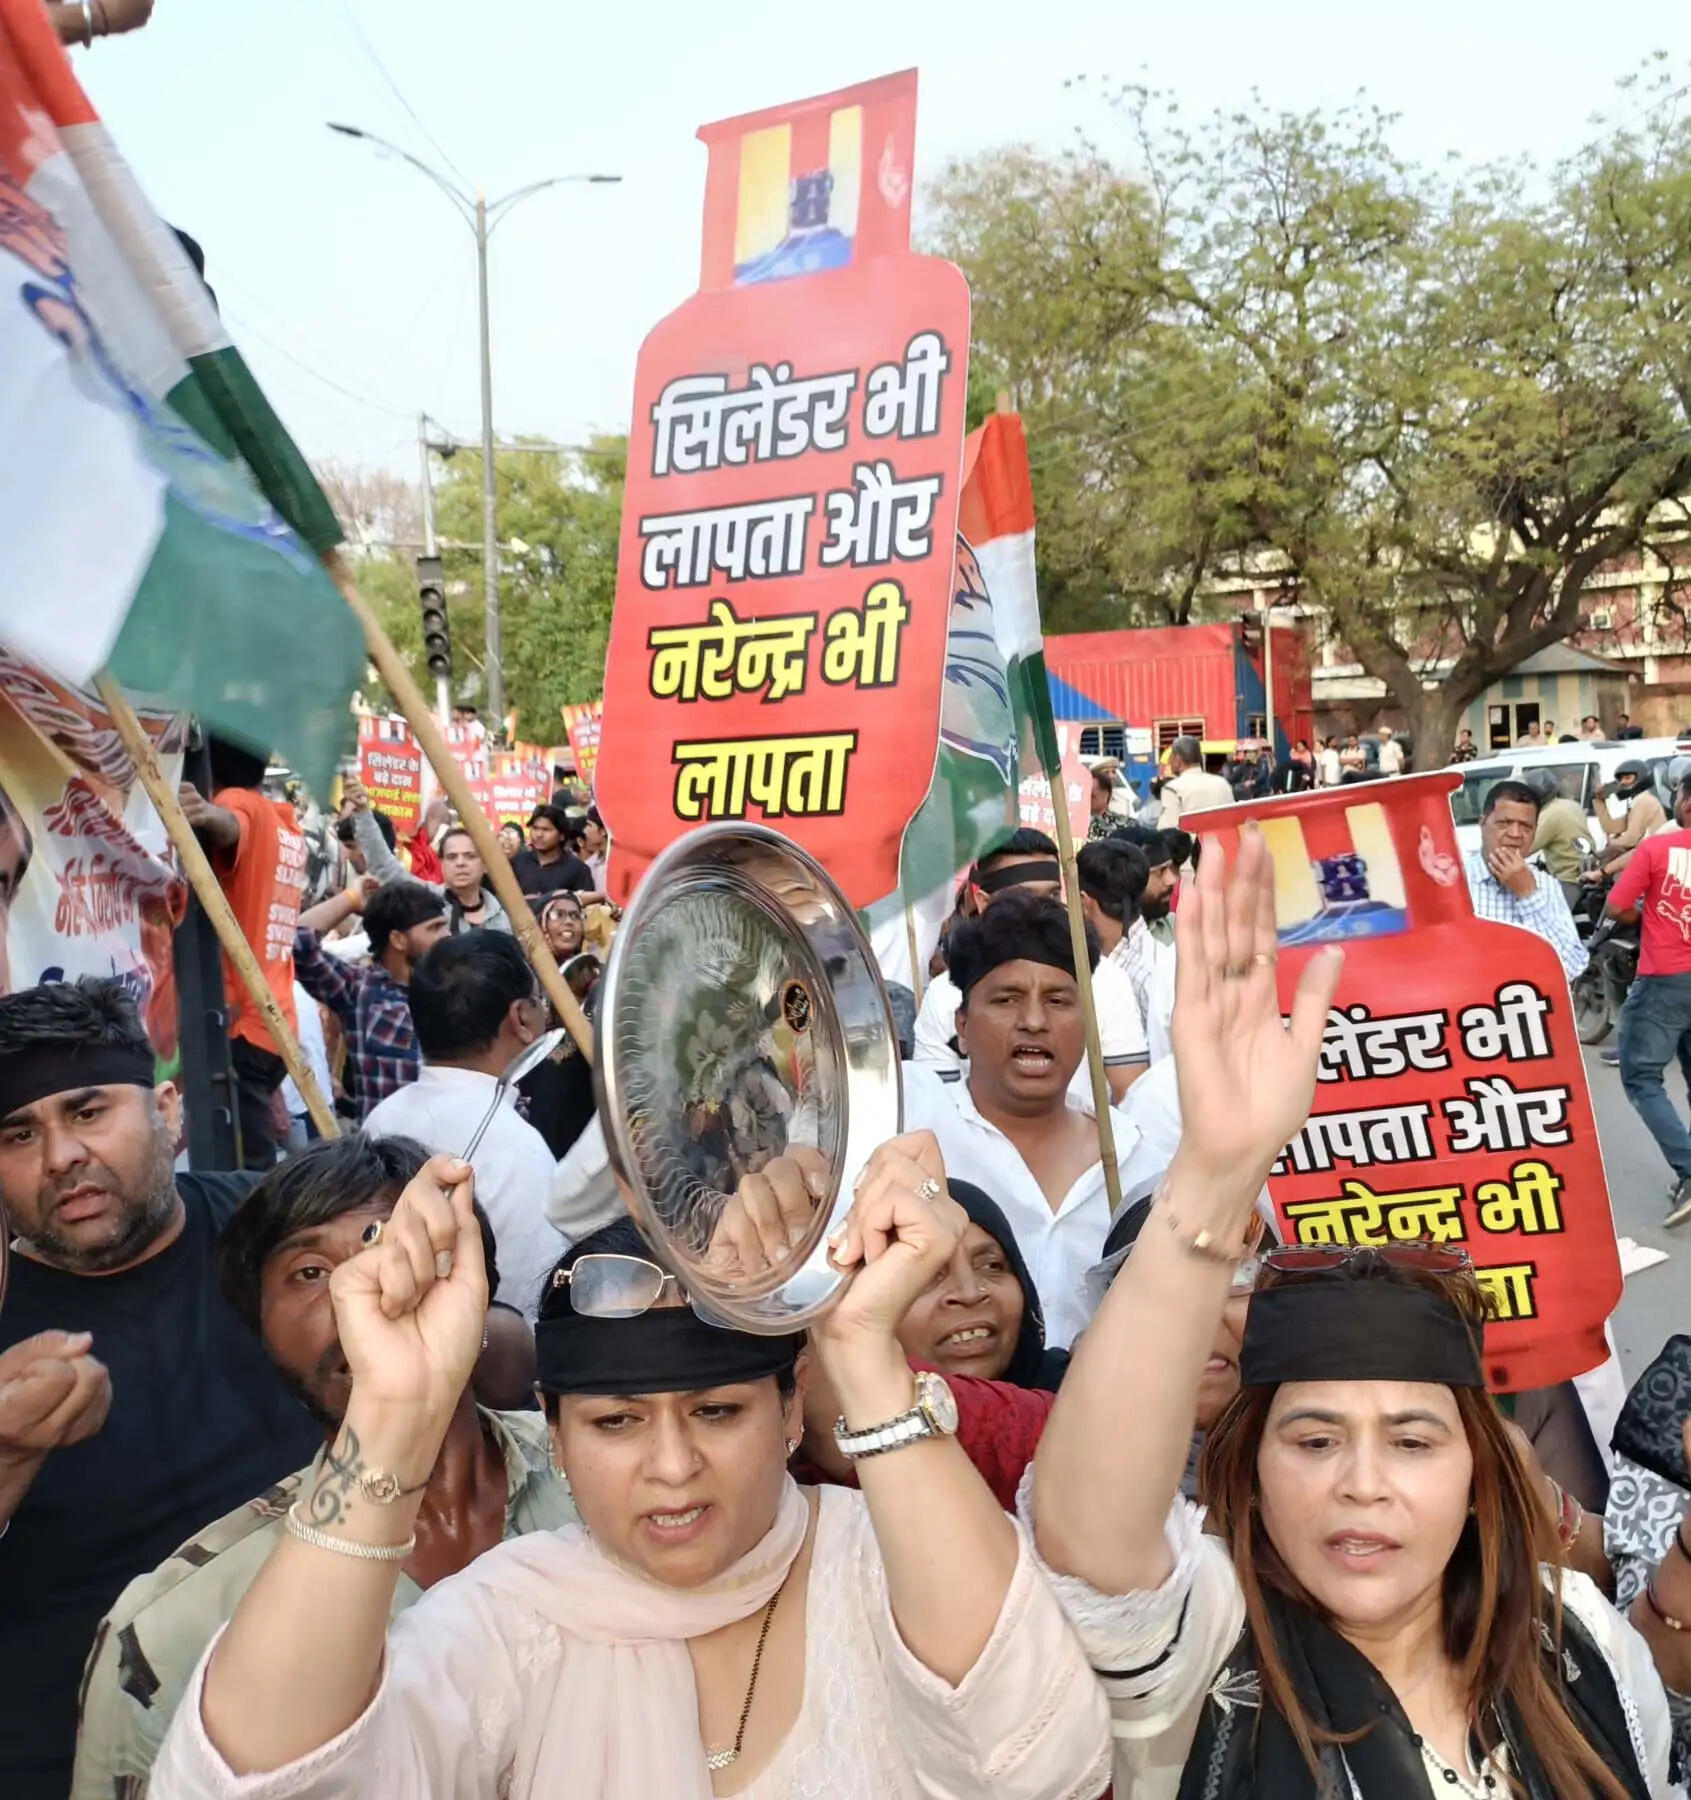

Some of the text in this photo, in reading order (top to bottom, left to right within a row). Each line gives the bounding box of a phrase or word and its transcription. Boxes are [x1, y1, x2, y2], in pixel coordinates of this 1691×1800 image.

[651, 330, 950, 477] सिलेंडर भी
[639, 459, 944, 590] लापता और
[649, 579, 909, 704] नरेन्द्र भी
[672, 729, 859, 821] लापता
[1457, 980, 1553, 1063] भी
[1440, 1075, 1573, 1153] और
[1474, 1160, 1563, 1234] भी
